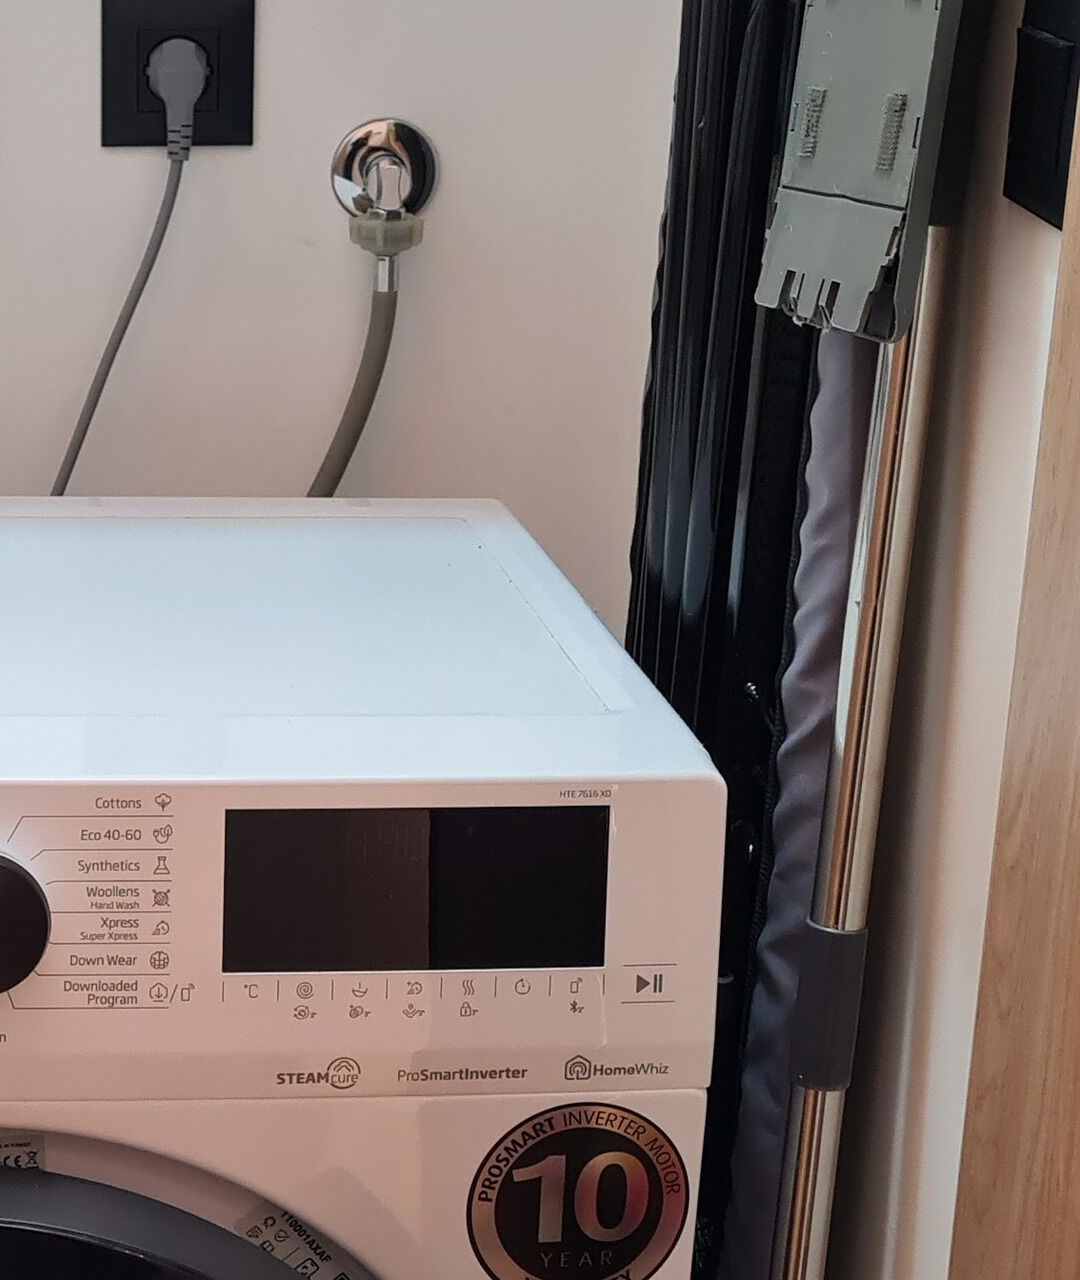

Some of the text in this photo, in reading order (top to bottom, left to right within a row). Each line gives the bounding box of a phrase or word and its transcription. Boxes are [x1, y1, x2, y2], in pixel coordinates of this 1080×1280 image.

[95, 796, 142, 809] Cottons
[80, 829, 142, 841] Eco 40-60
[77, 859, 141, 874] Synthetics
[86, 885, 140, 898] Woollens
[90, 901, 140, 910] Hand Wash
[100, 917, 140, 930] Xpress
[80, 932, 139, 942] Super Xpress
[70, 954, 137, 966] Down Wear
[63, 980, 139, 993] Downloaded
[87, 993, 139, 1007] Program
[397, 1066, 528, 1082] ProSmartInverter
[592, 1063, 669, 1076] HomeWhiz
[478, 1110, 681, 1203] PROSMART INVERTER MOTOR
[512, 1151, 649, 1244] 10
[540, 1251, 613, 1268] YEAR
